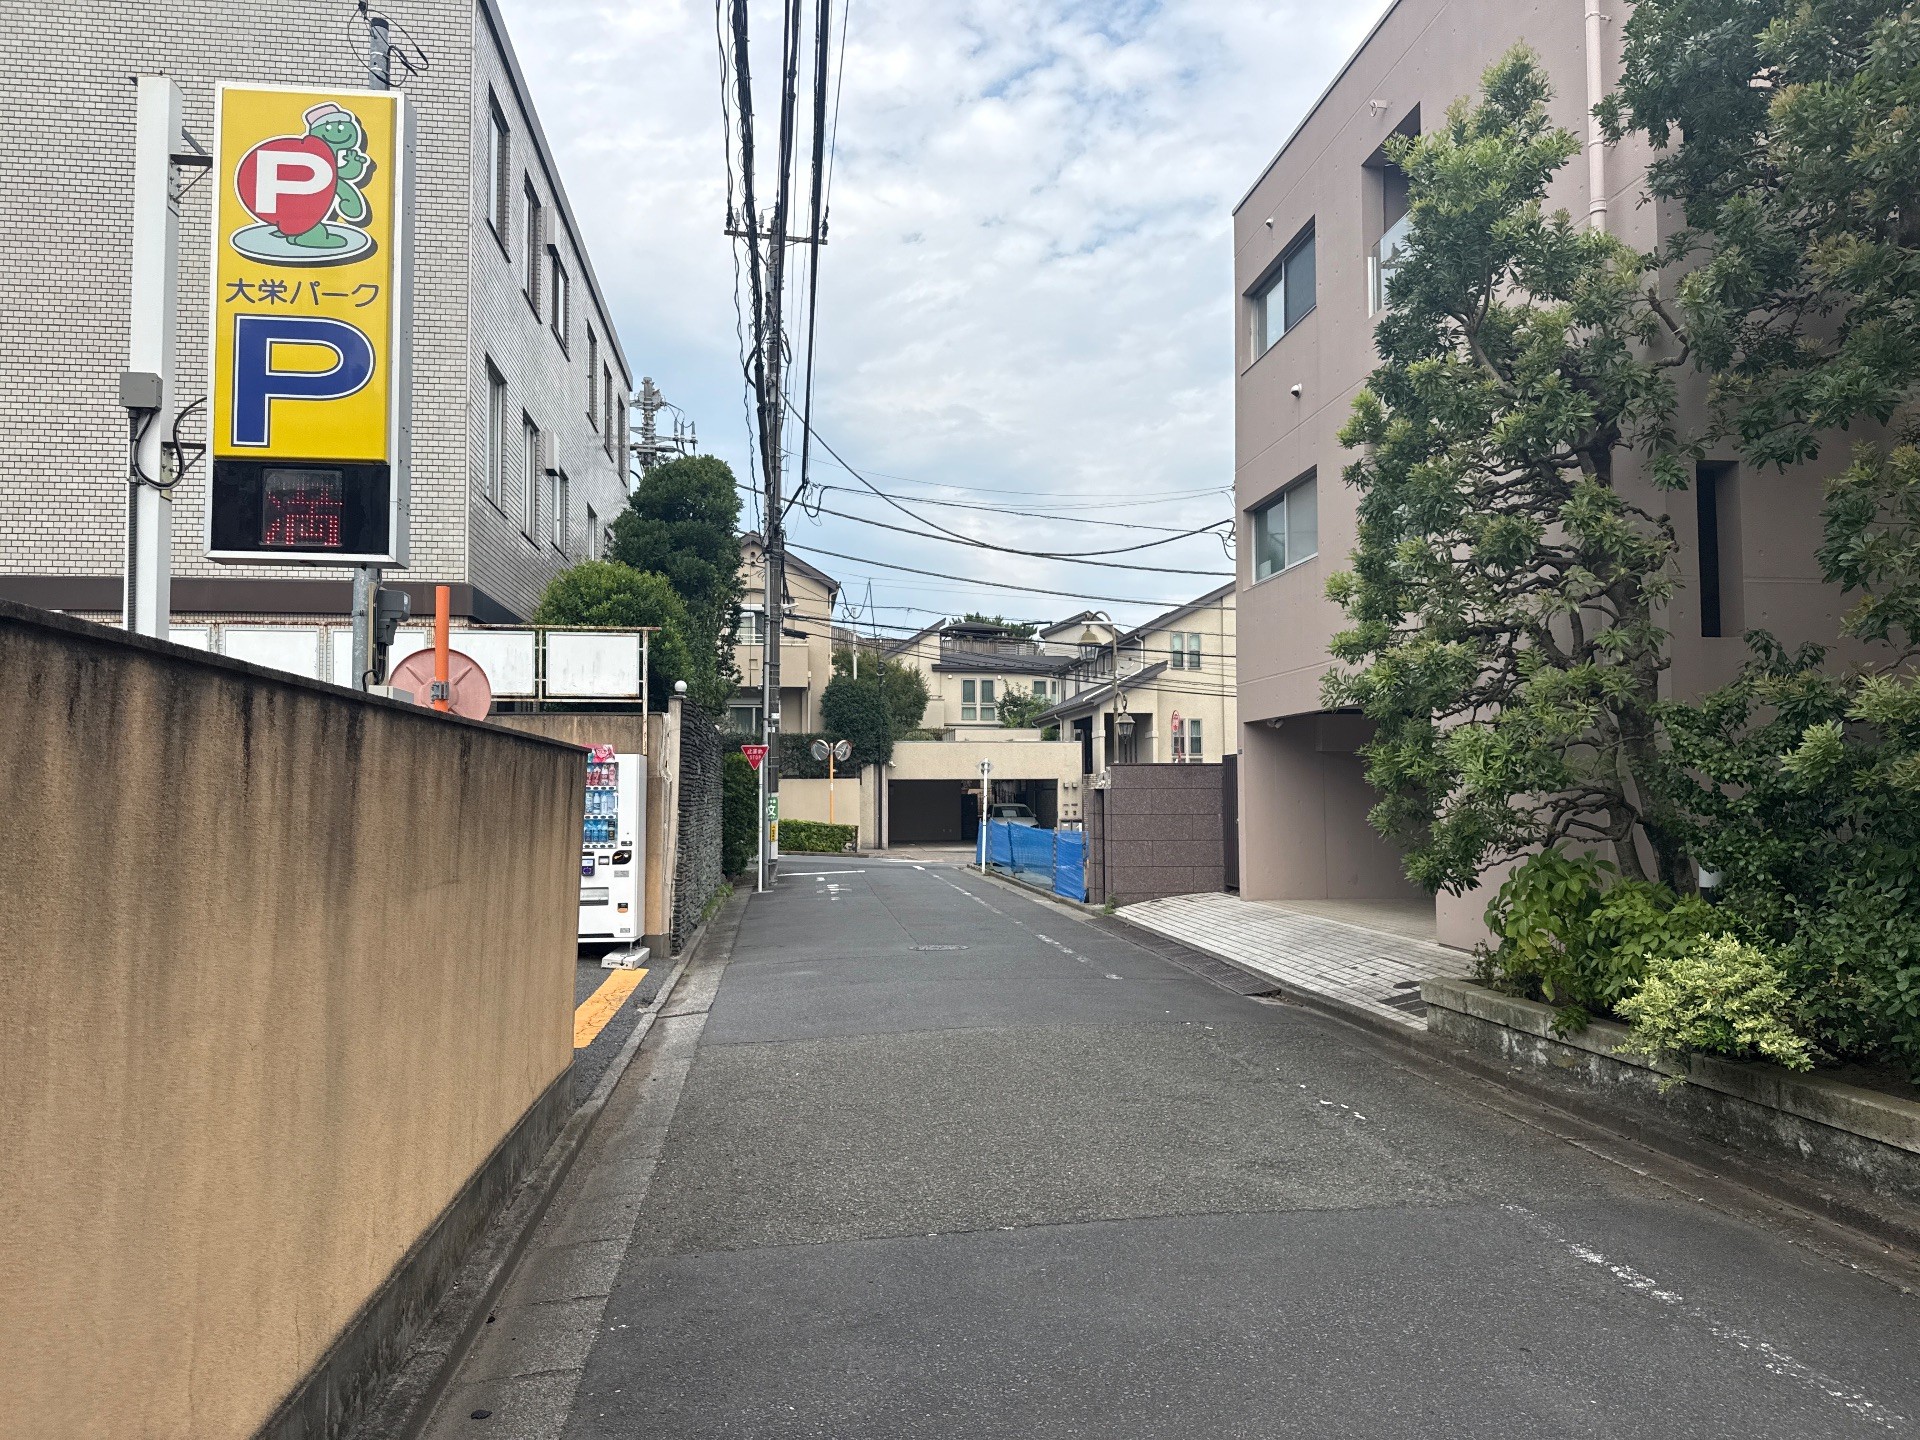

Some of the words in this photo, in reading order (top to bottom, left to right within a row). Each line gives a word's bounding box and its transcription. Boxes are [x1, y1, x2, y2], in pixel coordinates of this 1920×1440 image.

[255, 149, 333, 214] P
[225, 277, 380, 308] 大栄パーク
[230, 312, 377, 448] P
